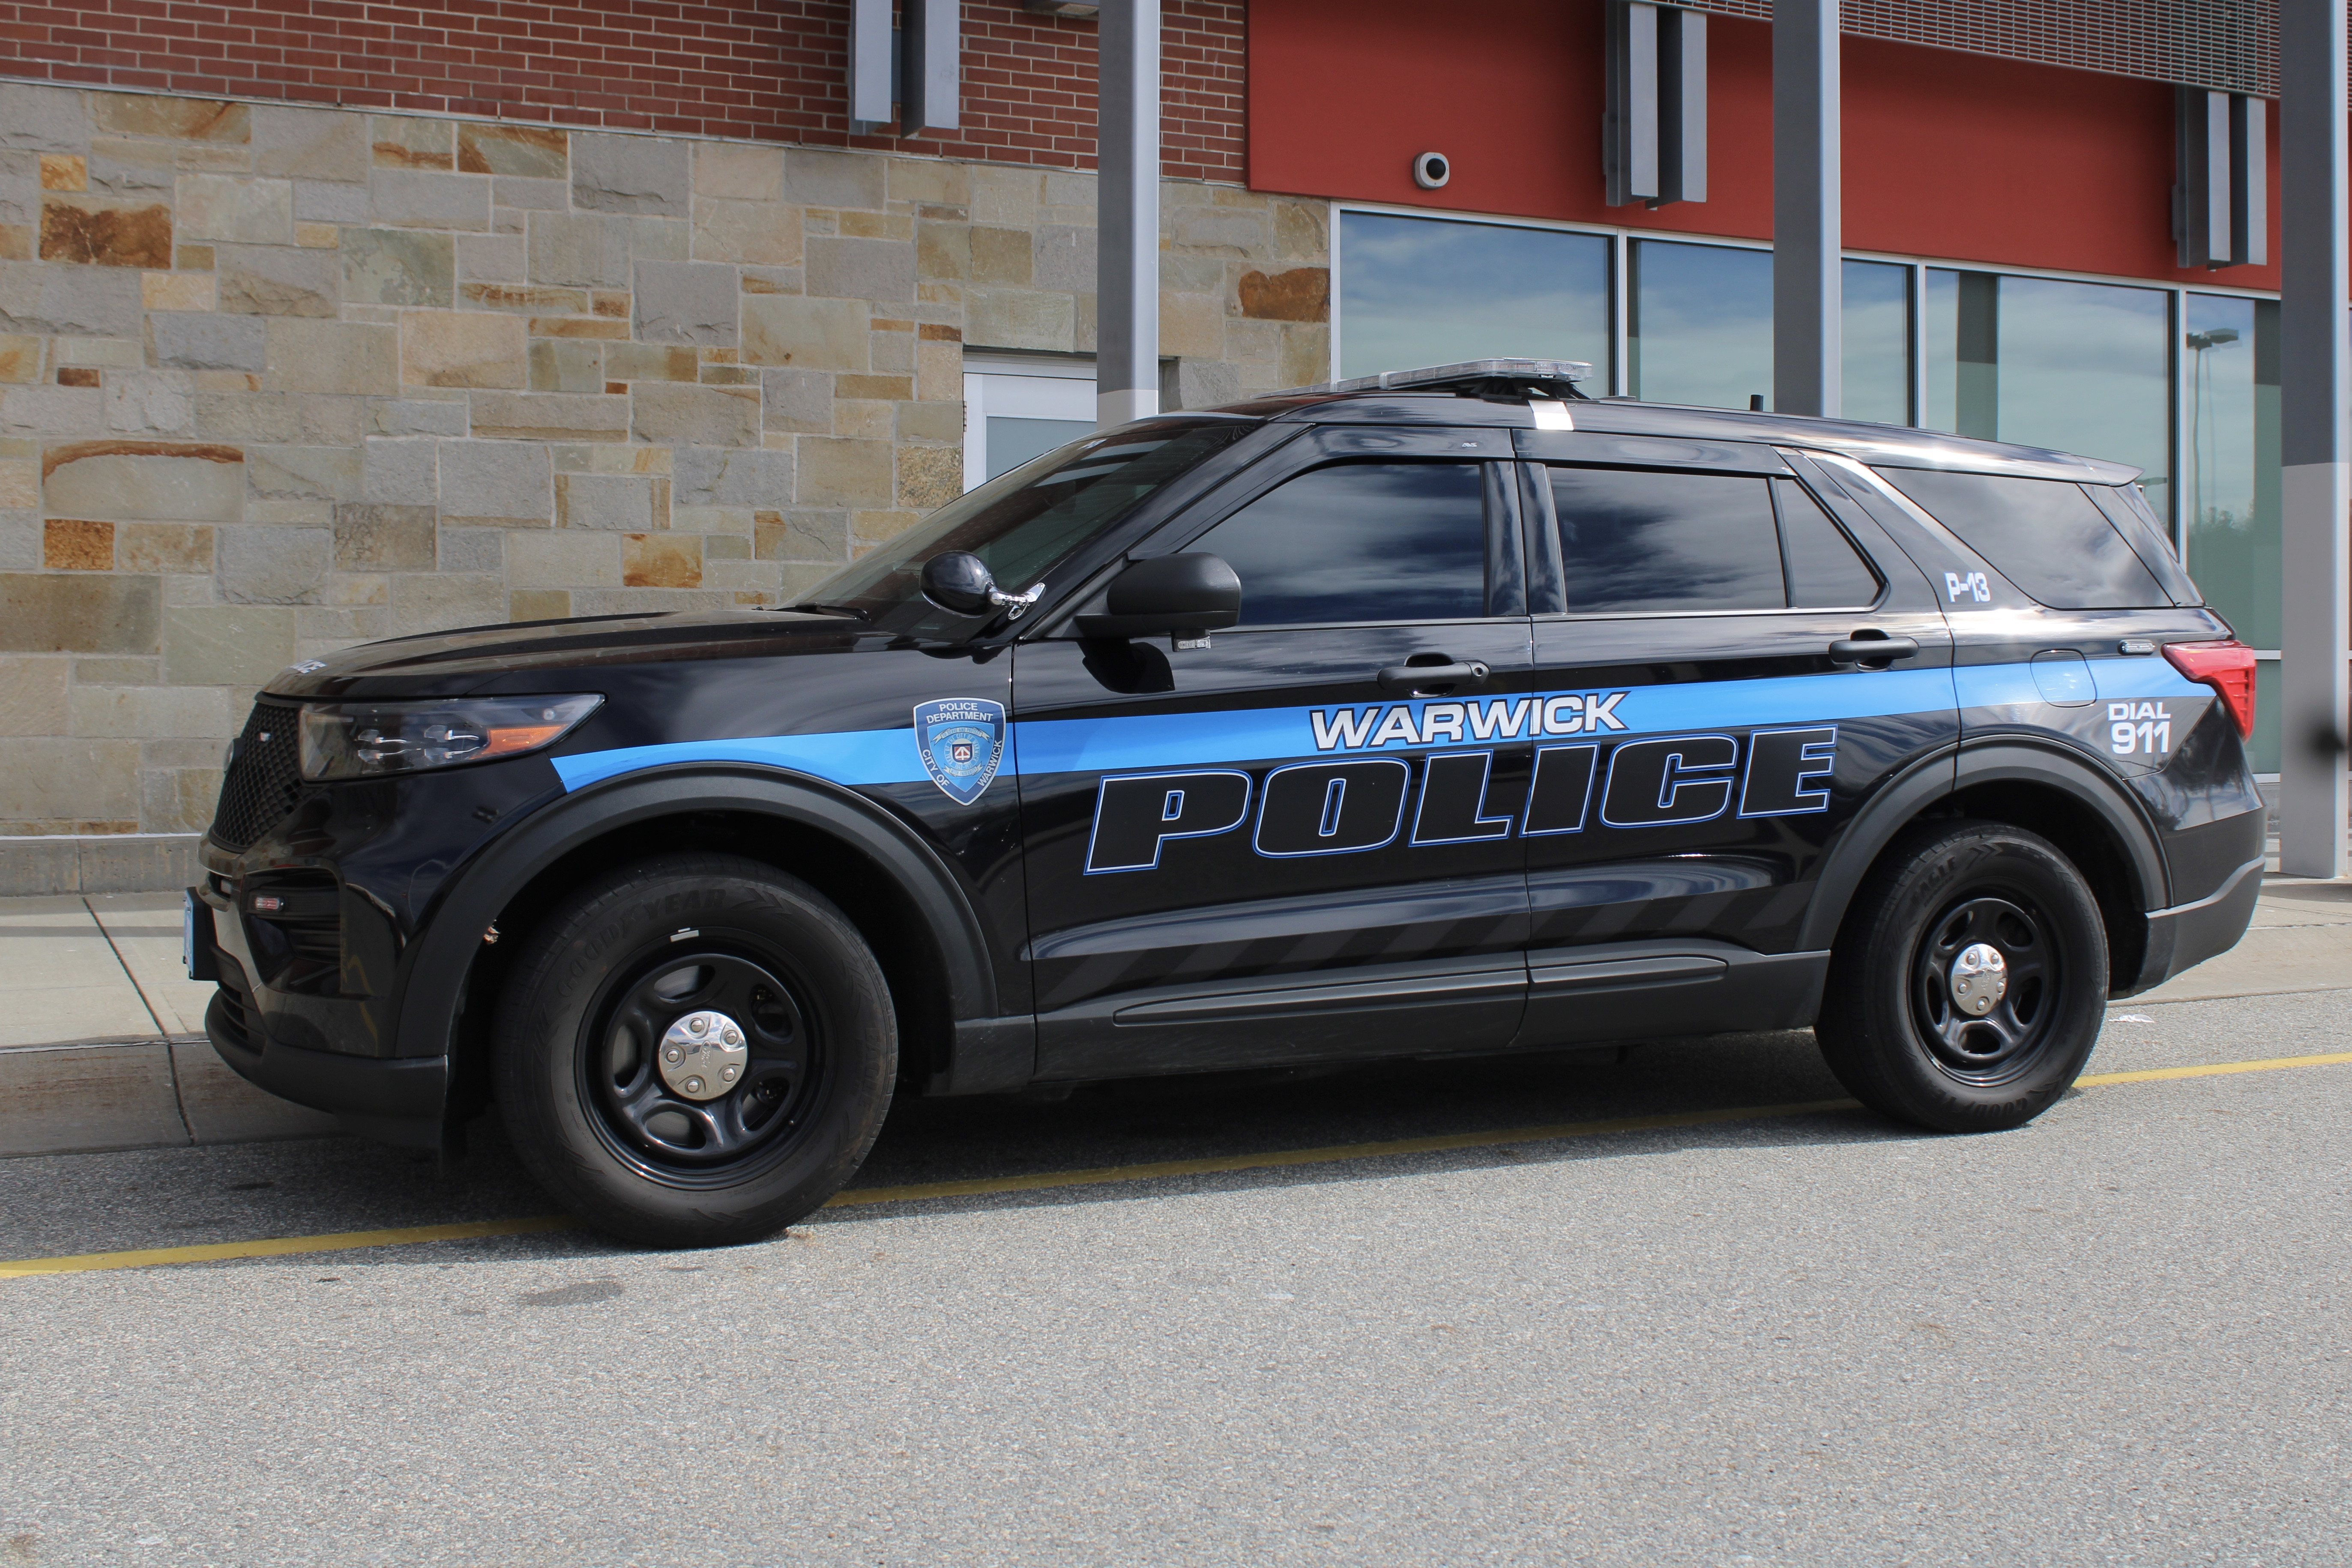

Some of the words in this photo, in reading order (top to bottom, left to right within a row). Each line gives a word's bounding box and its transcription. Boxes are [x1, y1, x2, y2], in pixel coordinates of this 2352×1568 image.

[1944, 572, 1990, 603] P-13
[926, 712, 993, 724] DEPARTMENT
[939, 702, 978, 711] POLICE
[1310, 691, 1632, 751] WARWICK
[2108, 701, 2172, 721] DIAL
[948, 736, 956, 744] THE
[2111, 721, 2170, 754] 911
[922, 749, 938, 772] CITY
[937, 774, 950, 787] OF
[977, 740, 1002, 787] WARWICK
[1083, 724, 1838, 875] POLICE
[1910, 855, 1956, 907] EAGLE
[557, 888, 727, 998] GOODYEAR
[858, 1028, 881, 1111] EAGLE
